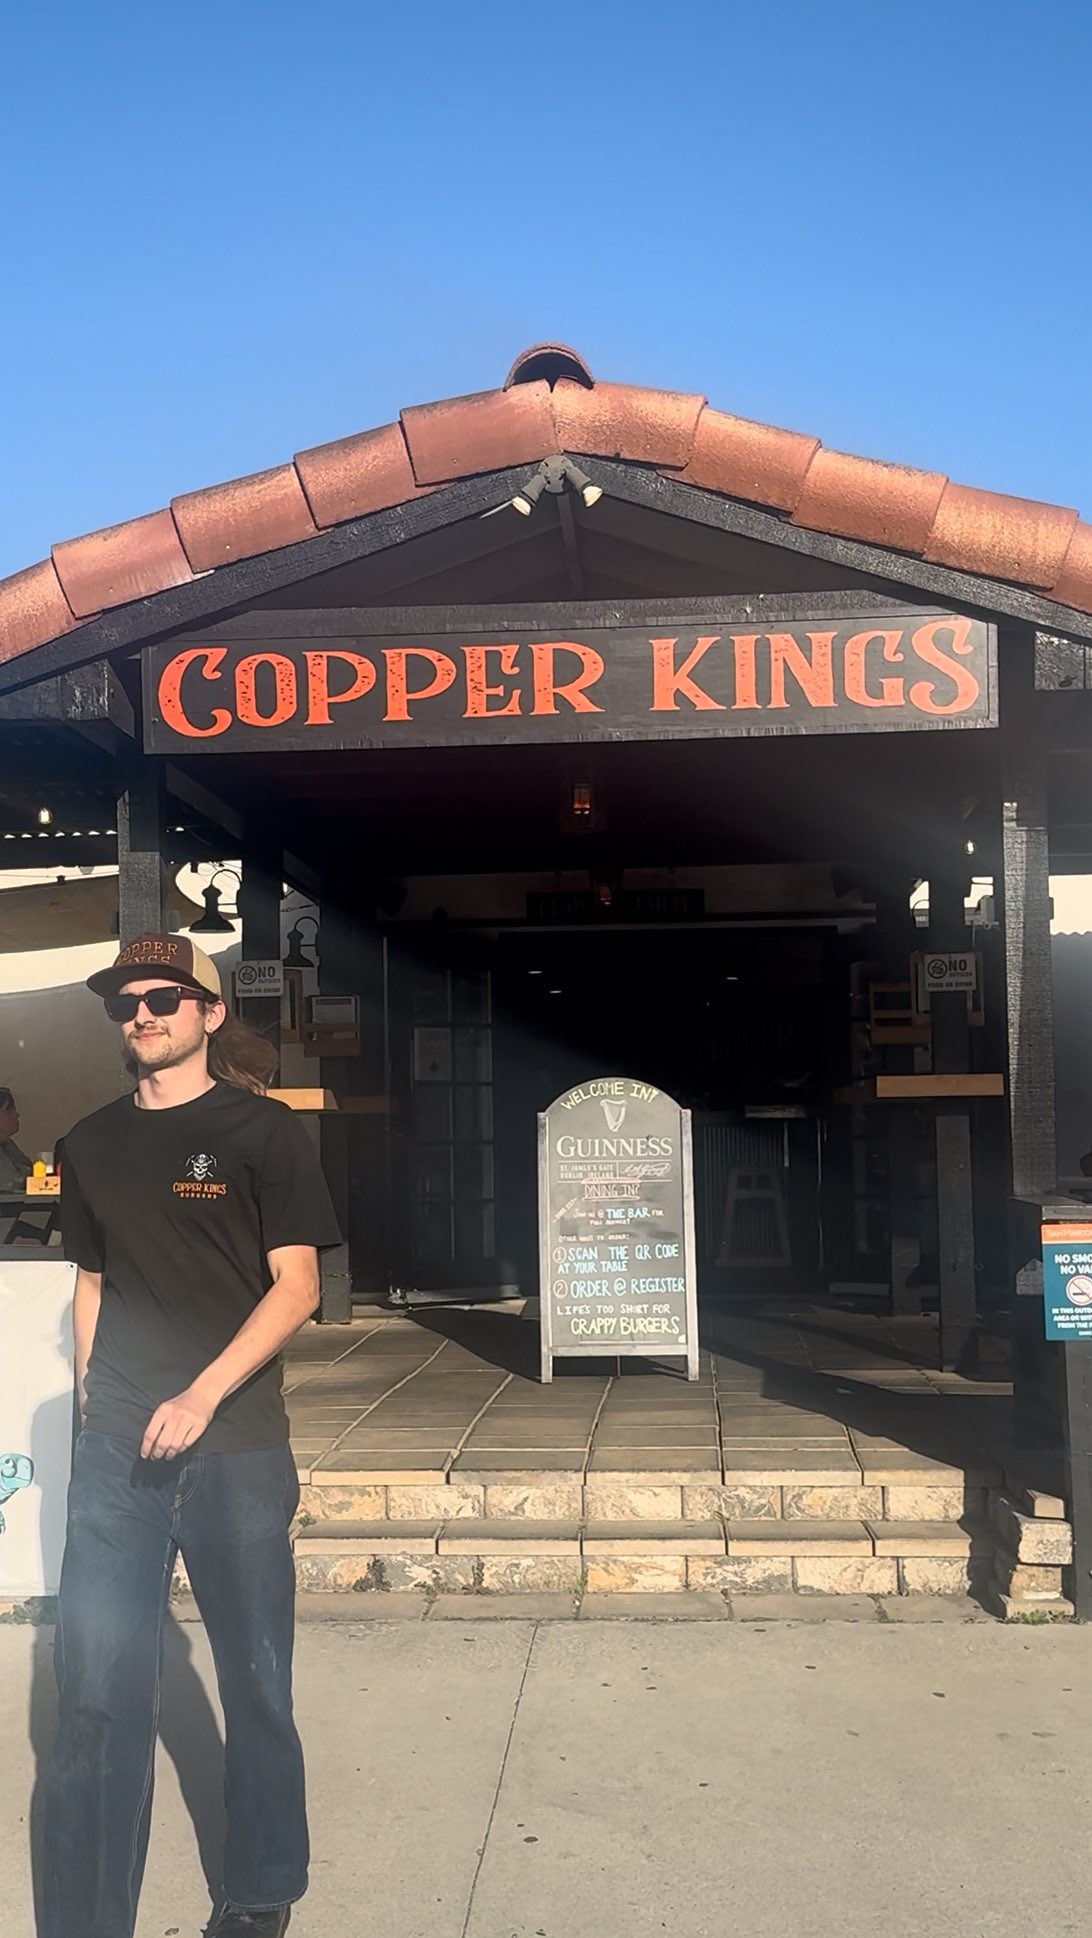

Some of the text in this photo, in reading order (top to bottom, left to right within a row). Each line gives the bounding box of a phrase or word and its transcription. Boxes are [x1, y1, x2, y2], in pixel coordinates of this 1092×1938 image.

[156, 617, 980, 739] COPPER KINGS
[258, 966, 275, 977] NO
[949, 960, 967, 971] NO
[560, 1082, 659, 1110] WELCOME IN!
[556, 1136, 672, 1158] GUINNESS
[172, 1182, 227, 1195] COPPER KINGS
[584, 1184, 618, 1196] DINING
[606, 1208, 626, 1218] THE
[628, 1207, 650, 1218] BAR
[568, 1246, 598, 1262] SCAN
[609, 1246, 629, 1260] THE
[635, 1245, 652, 1260] QR
[655, 1244, 679, 1257] CODE
[1054, 1254, 1070, 1264] NO
[557, 1261, 628, 1274] AT YOUR TABLE
[1060, 1265, 1076, 1274] NO
[570, 1280, 612, 1298] ORDER
[614, 1278, 627, 1296] @
[631, 1277, 685, 1294] REGISTER
[598, 1305, 614, 1314] TOO
[620, 1304, 649, 1314] SHORT
[652, 1303, 671, 1314] FOR
[570, 1317, 680, 1335] CRAPPY BURGERS
